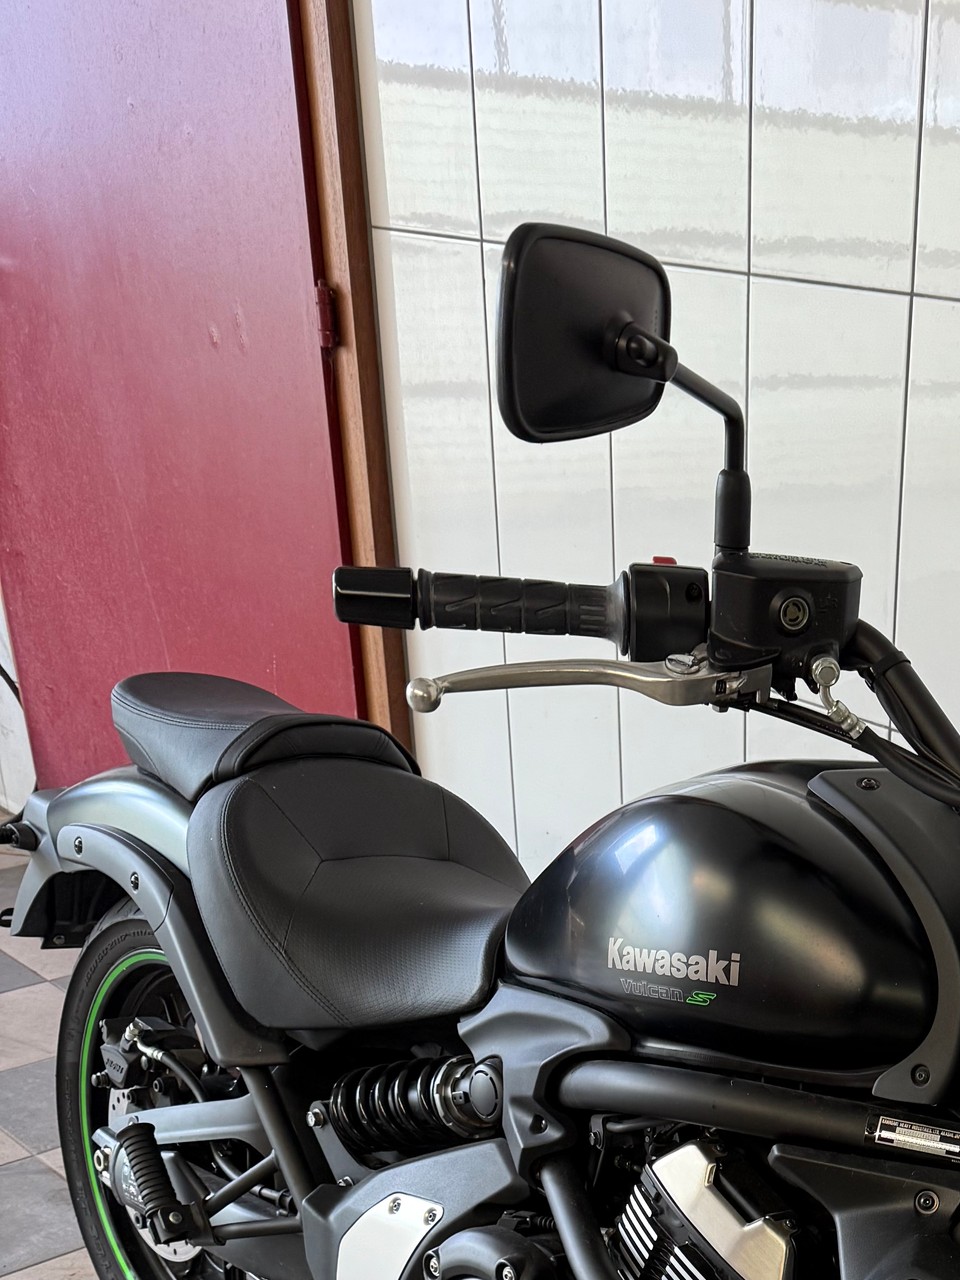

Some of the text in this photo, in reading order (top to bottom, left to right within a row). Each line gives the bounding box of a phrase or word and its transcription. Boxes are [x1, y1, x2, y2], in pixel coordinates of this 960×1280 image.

[607, 937, 741, 987] Kawasaki
[620, 978, 718, 1007] Vulcan S
